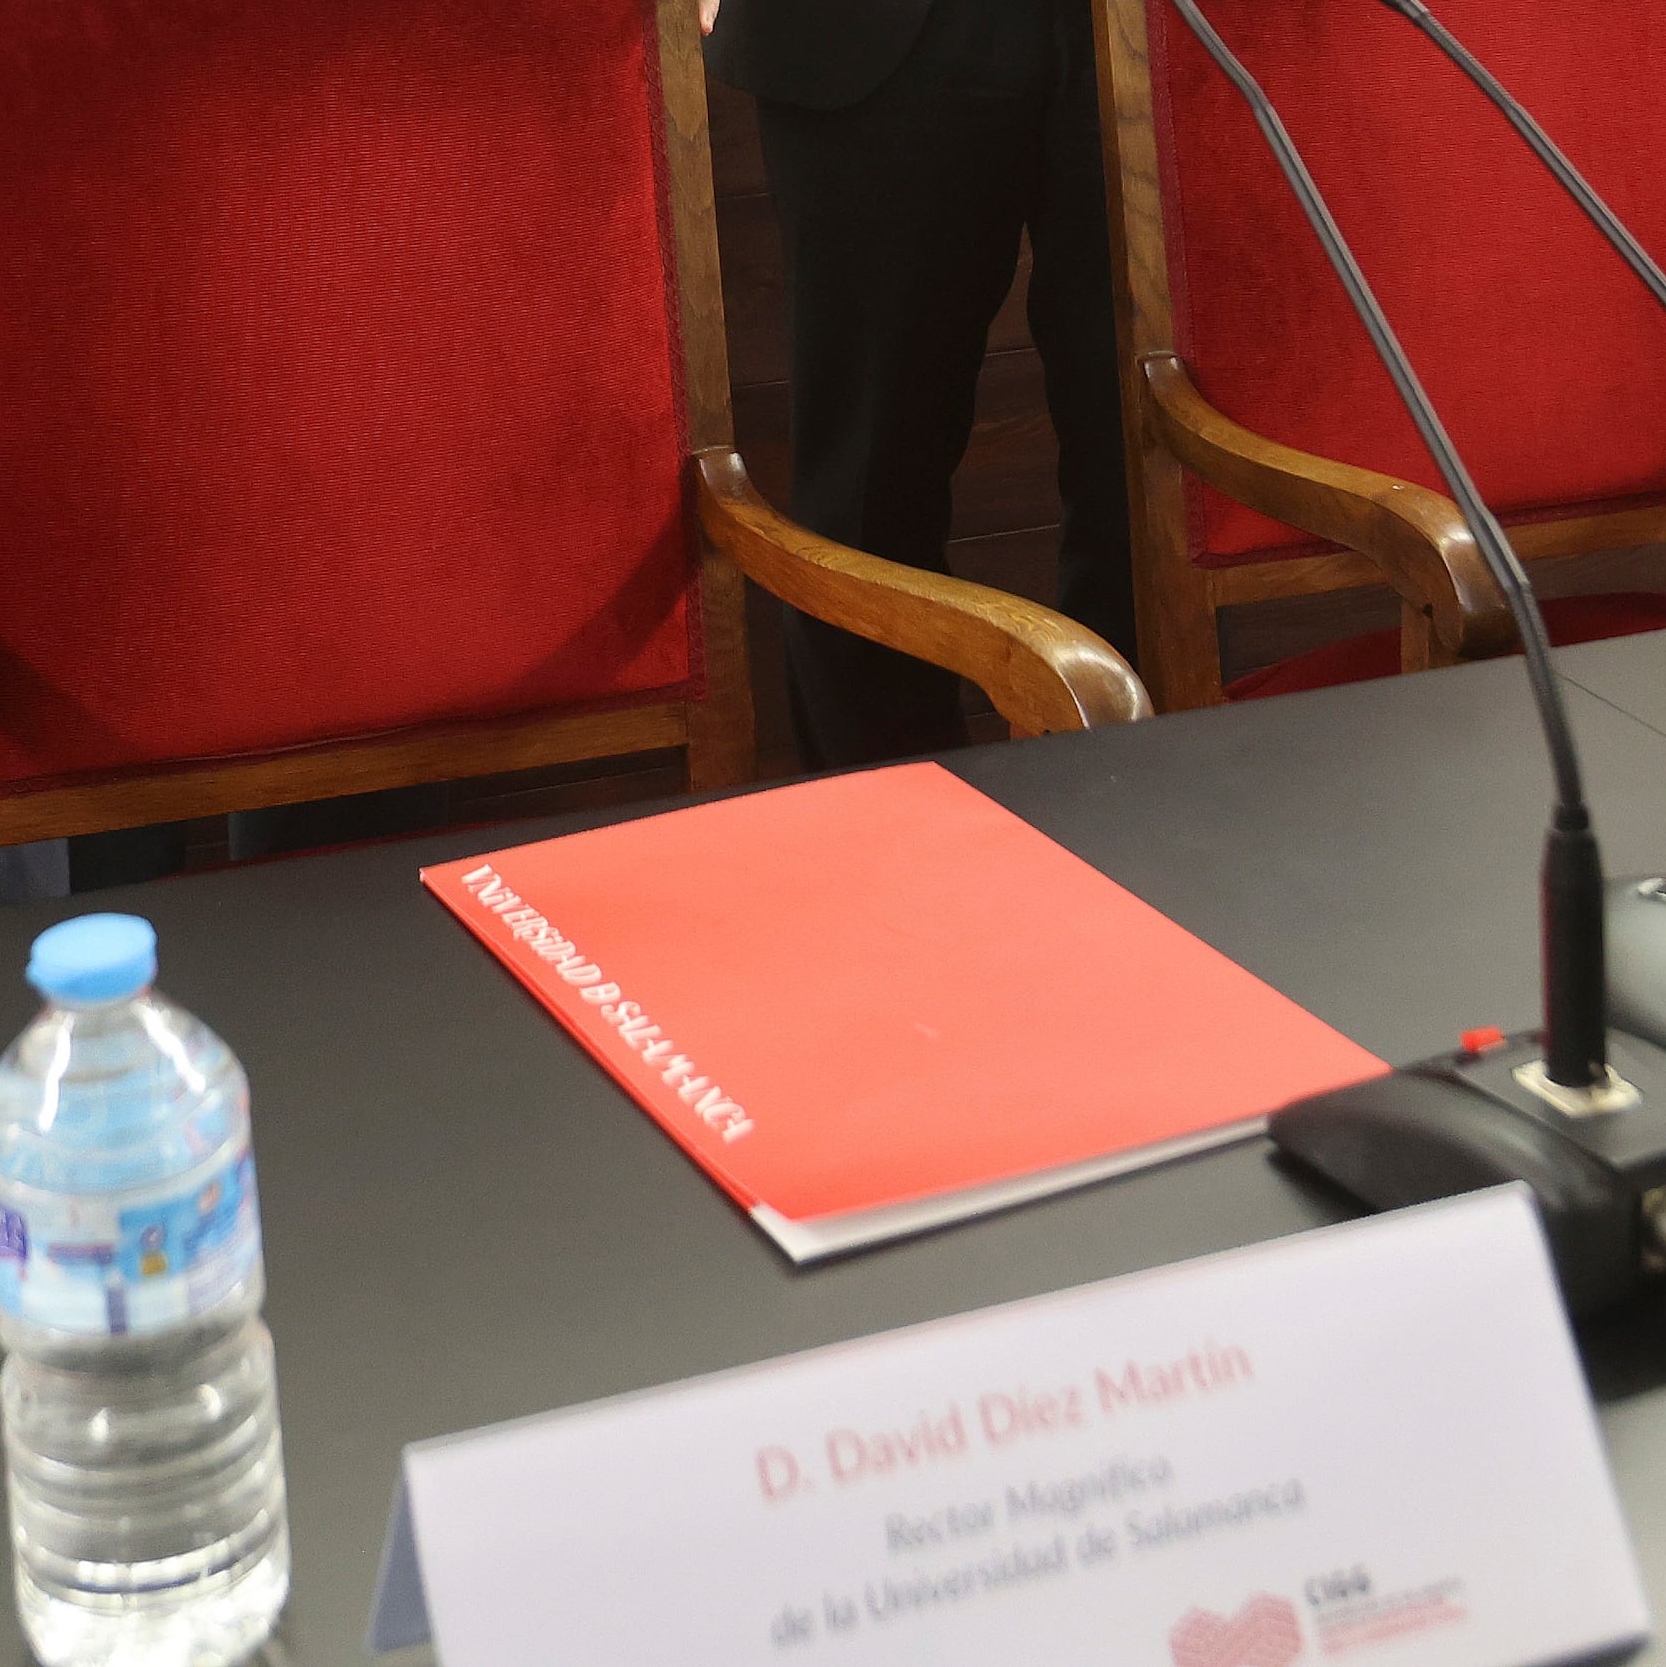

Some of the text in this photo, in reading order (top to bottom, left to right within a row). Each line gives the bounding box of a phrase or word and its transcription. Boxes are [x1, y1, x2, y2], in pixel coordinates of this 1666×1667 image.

[755, 1442, 815, 1504] D.
[824, 1402, 969, 1485] David
[771, 1476, 1305, 1648] de la Universidad de Salamanca
[884, 1501, 995, 1556] Rector
